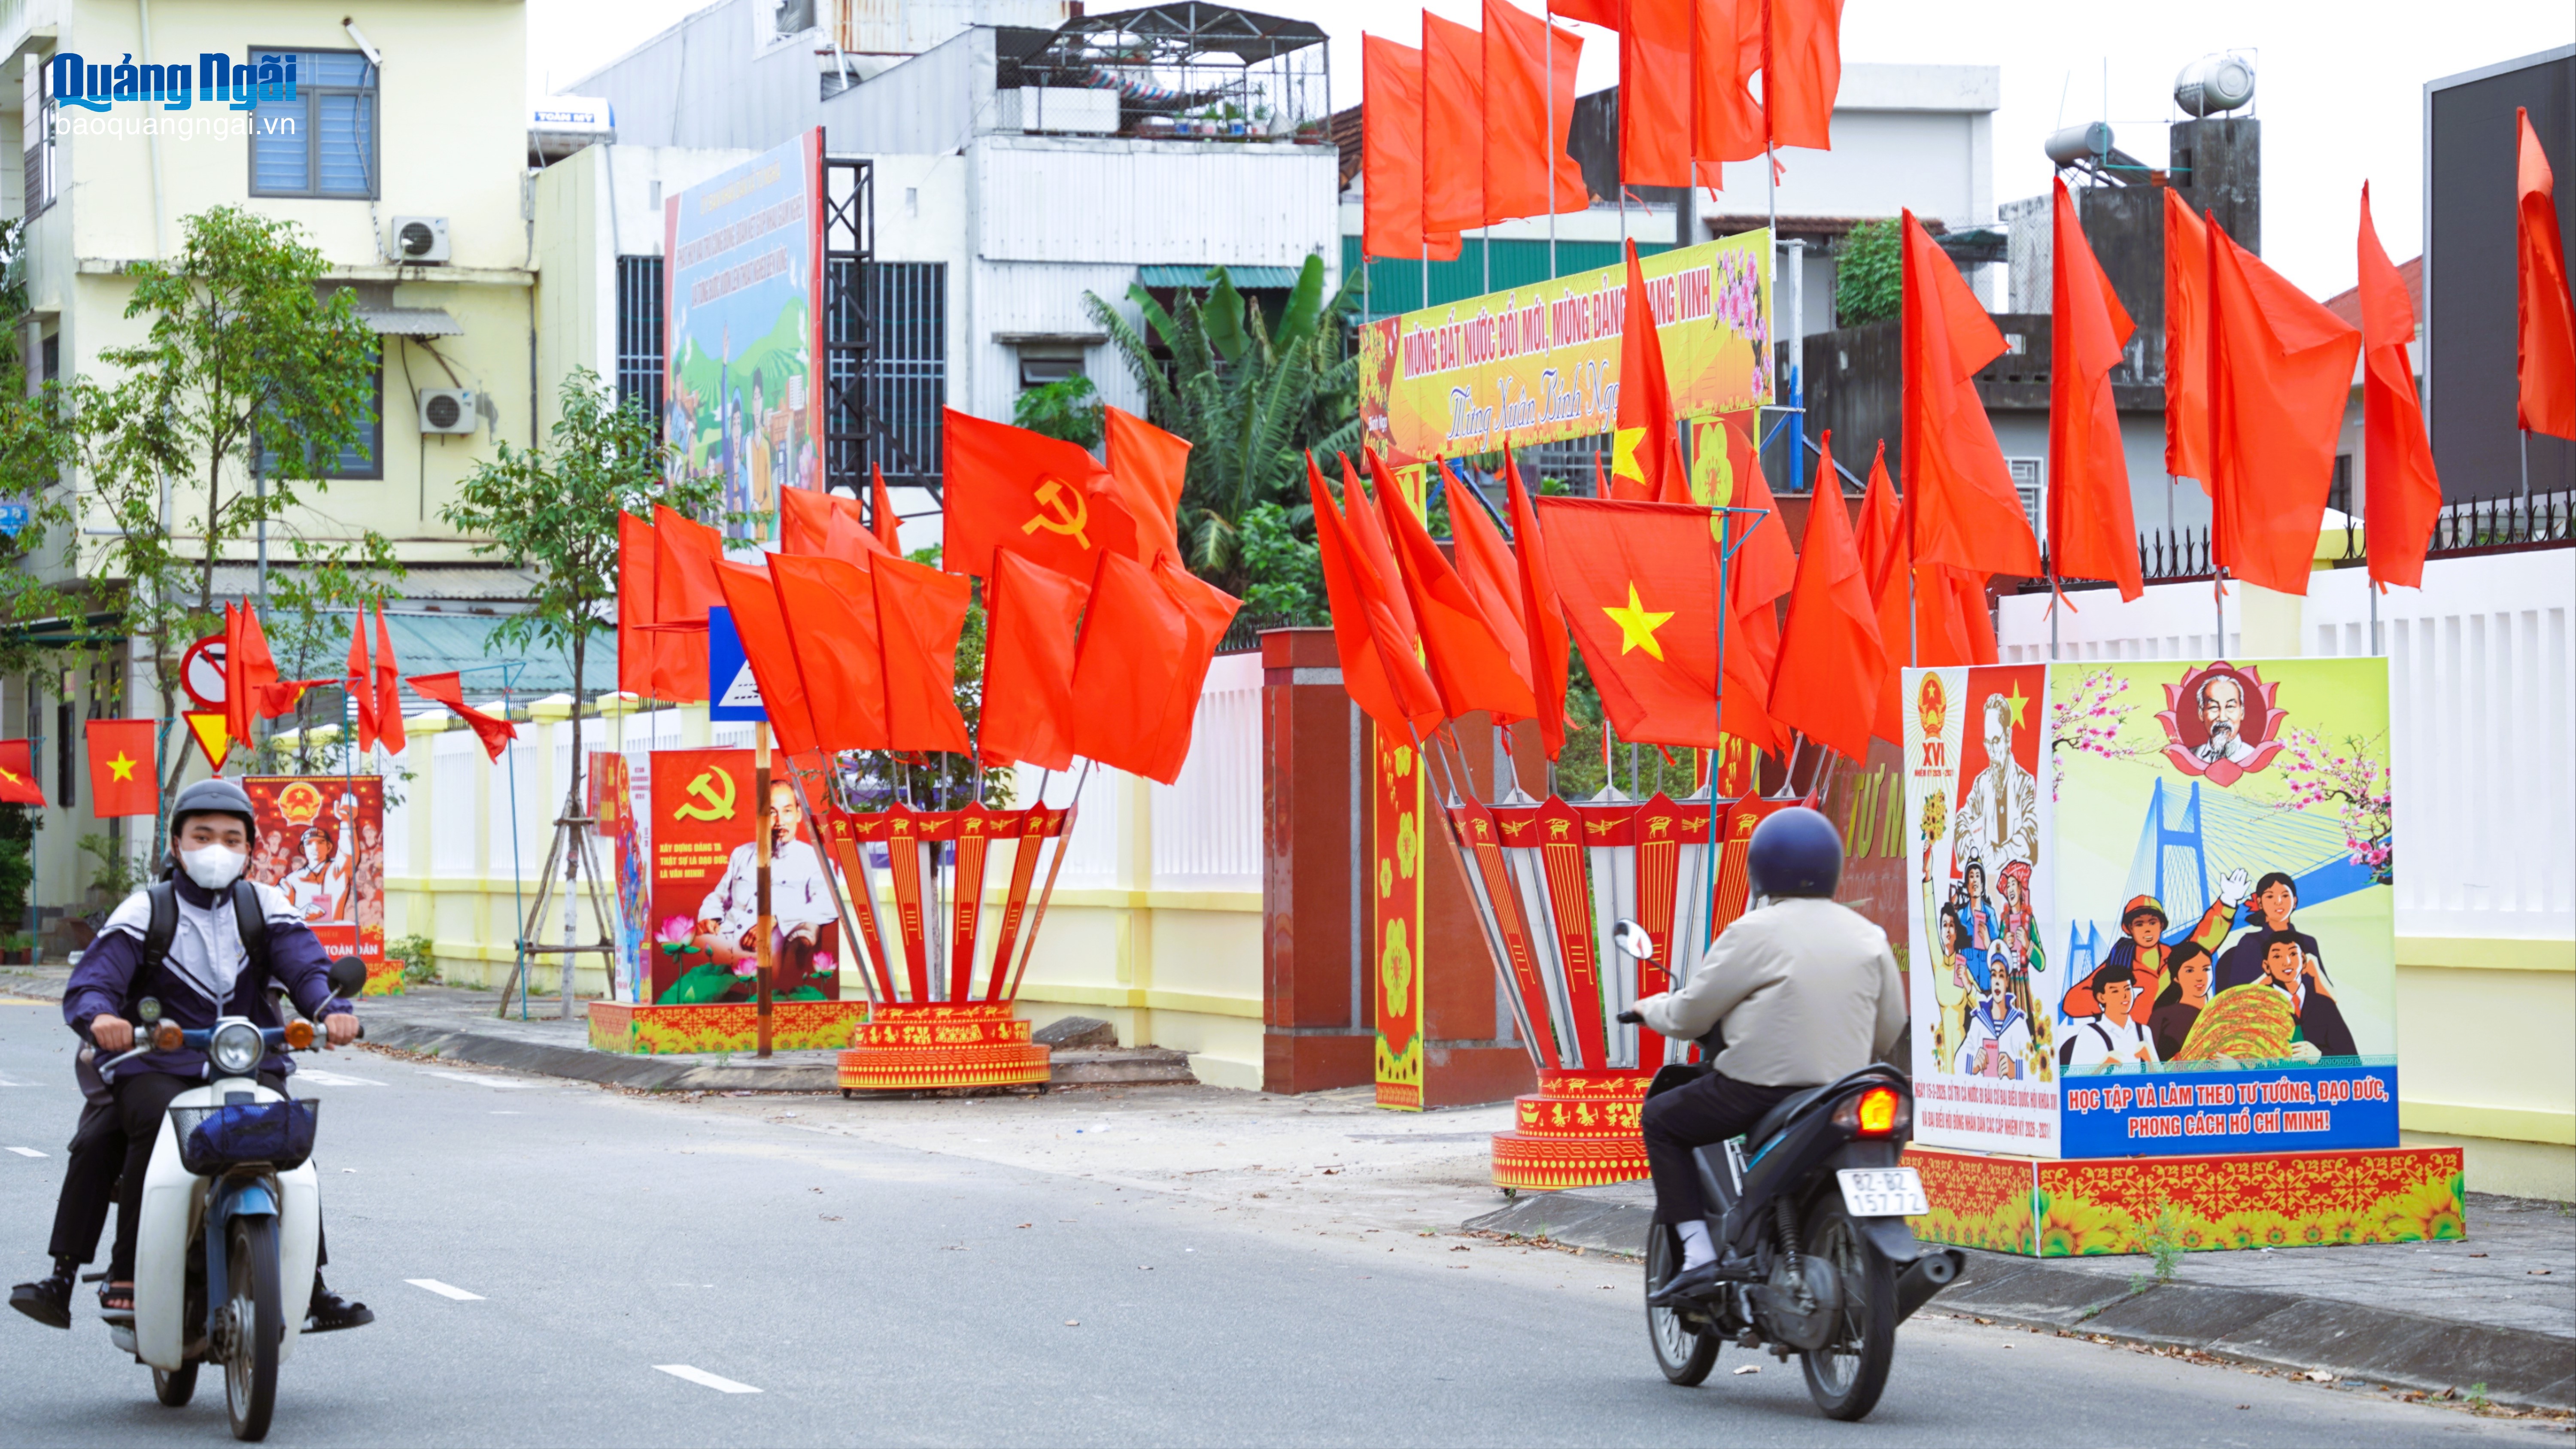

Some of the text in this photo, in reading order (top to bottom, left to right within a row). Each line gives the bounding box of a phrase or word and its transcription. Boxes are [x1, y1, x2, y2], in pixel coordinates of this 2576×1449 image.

[1403, 322, 1437, 380] MỪNG
[1440, 307, 1461, 372] ĐẤT
[1463, 306, 1496, 367] NƯỚC
[1498, 292, 1519, 361] ĐỔI
[1522, 297, 1549, 357] MỚI,
[1552, 288, 1589, 349] MỪNG
[1644, 273, 1675, 328] ANG
[1678, 265, 1711, 323] VINH
[1447, 385, 1492, 453] Mừng
[1494, 376, 1535, 431] Xuân
[1539, 362, 1581, 424] Bính
[1586, 359, 1619, 431] Ngọ
[1922, 742, 1945, 766] XVI
[324, 943, 353, 956] TOÀN
[2069, 1076, 2389, 1114] HỌC TẬP VÀ LÀM THEO TƯ TƯỞNG, ĐẠO ĐỨC,
[2128, 1116, 2181, 1138] PHONG
[2185, 1111, 2225, 1136] CÁCH
[2254, 1109, 2280, 1133] CHÍ
[2284, 1111, 2330, 1132] MINH!
